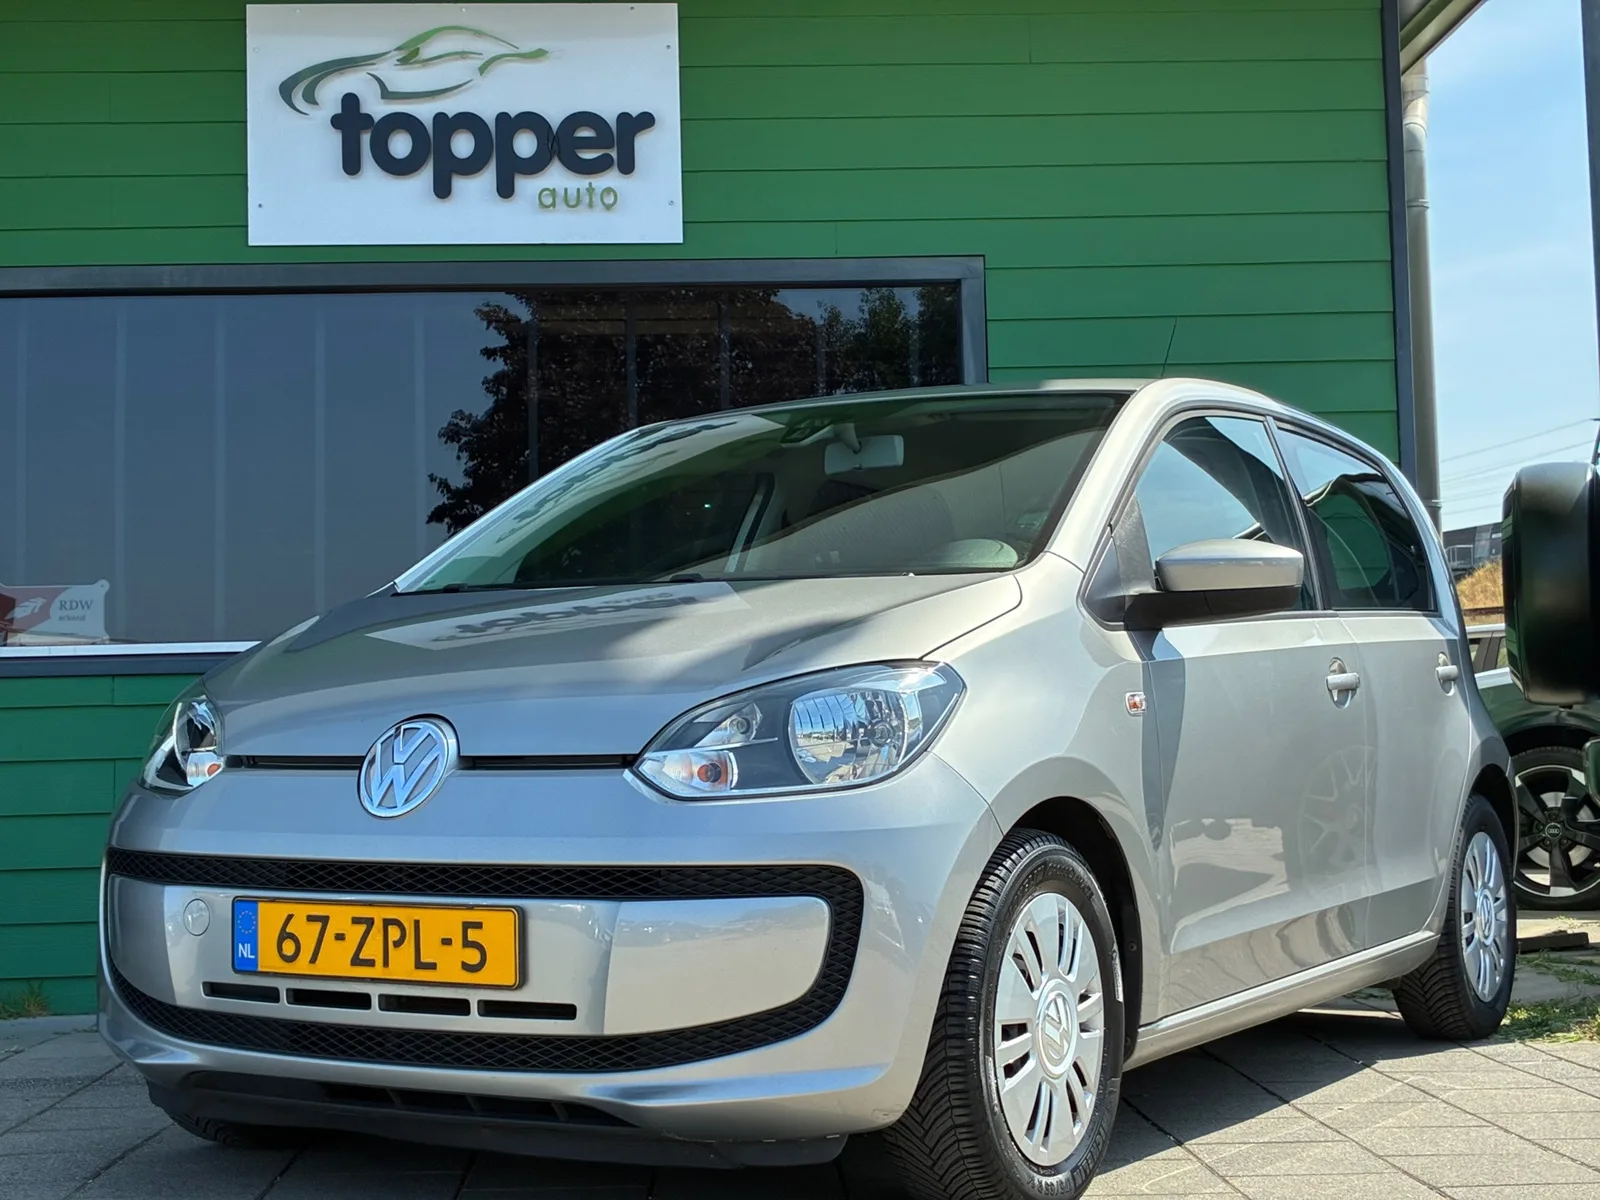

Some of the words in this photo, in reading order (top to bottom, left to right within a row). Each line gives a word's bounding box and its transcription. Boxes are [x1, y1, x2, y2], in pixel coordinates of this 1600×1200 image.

[330, 92, 656, 200] topper
[537, 181, 618, 211] auto
[58, 598, 94, 611] RDW
[238, 943, 256, 959] NL
[276, 913, 488, 974] 67-ZPL-5
